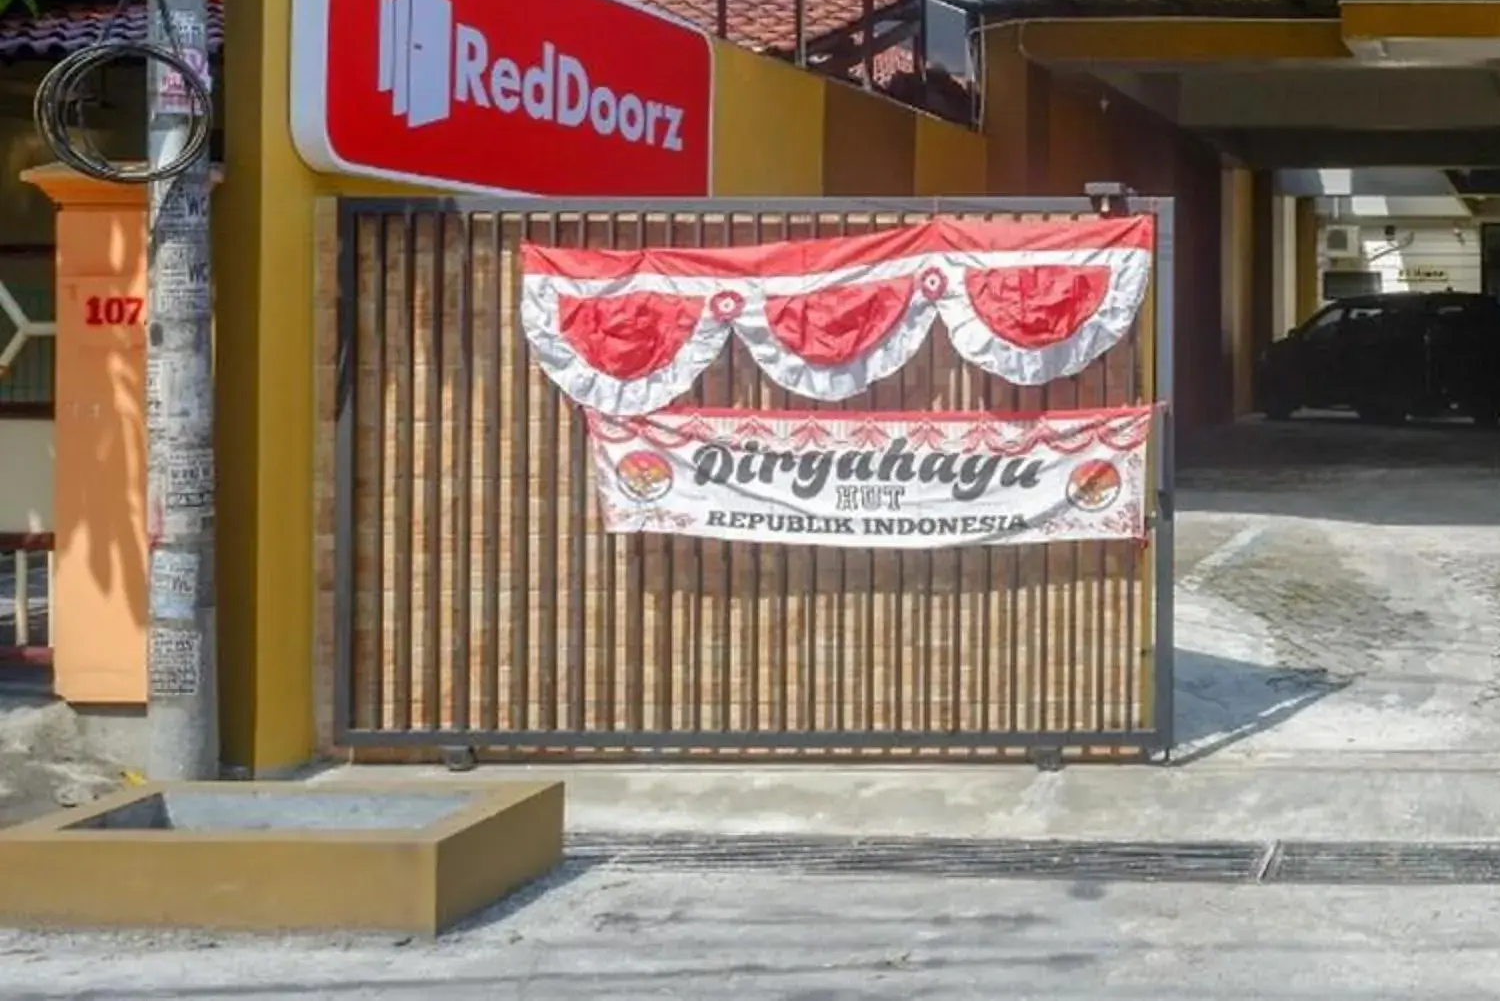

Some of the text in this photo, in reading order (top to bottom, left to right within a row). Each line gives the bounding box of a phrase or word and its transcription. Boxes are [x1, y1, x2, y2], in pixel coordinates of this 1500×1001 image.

[455, 22, 684, 152] RedDoorz
[86, 295, 143, 326] 107
[692, 437, 1045, 501] Dirgahayu
[835, 485, 906, 511] HUT
[706, 510, 1030, 536] REPUBLIK INDONESIA
